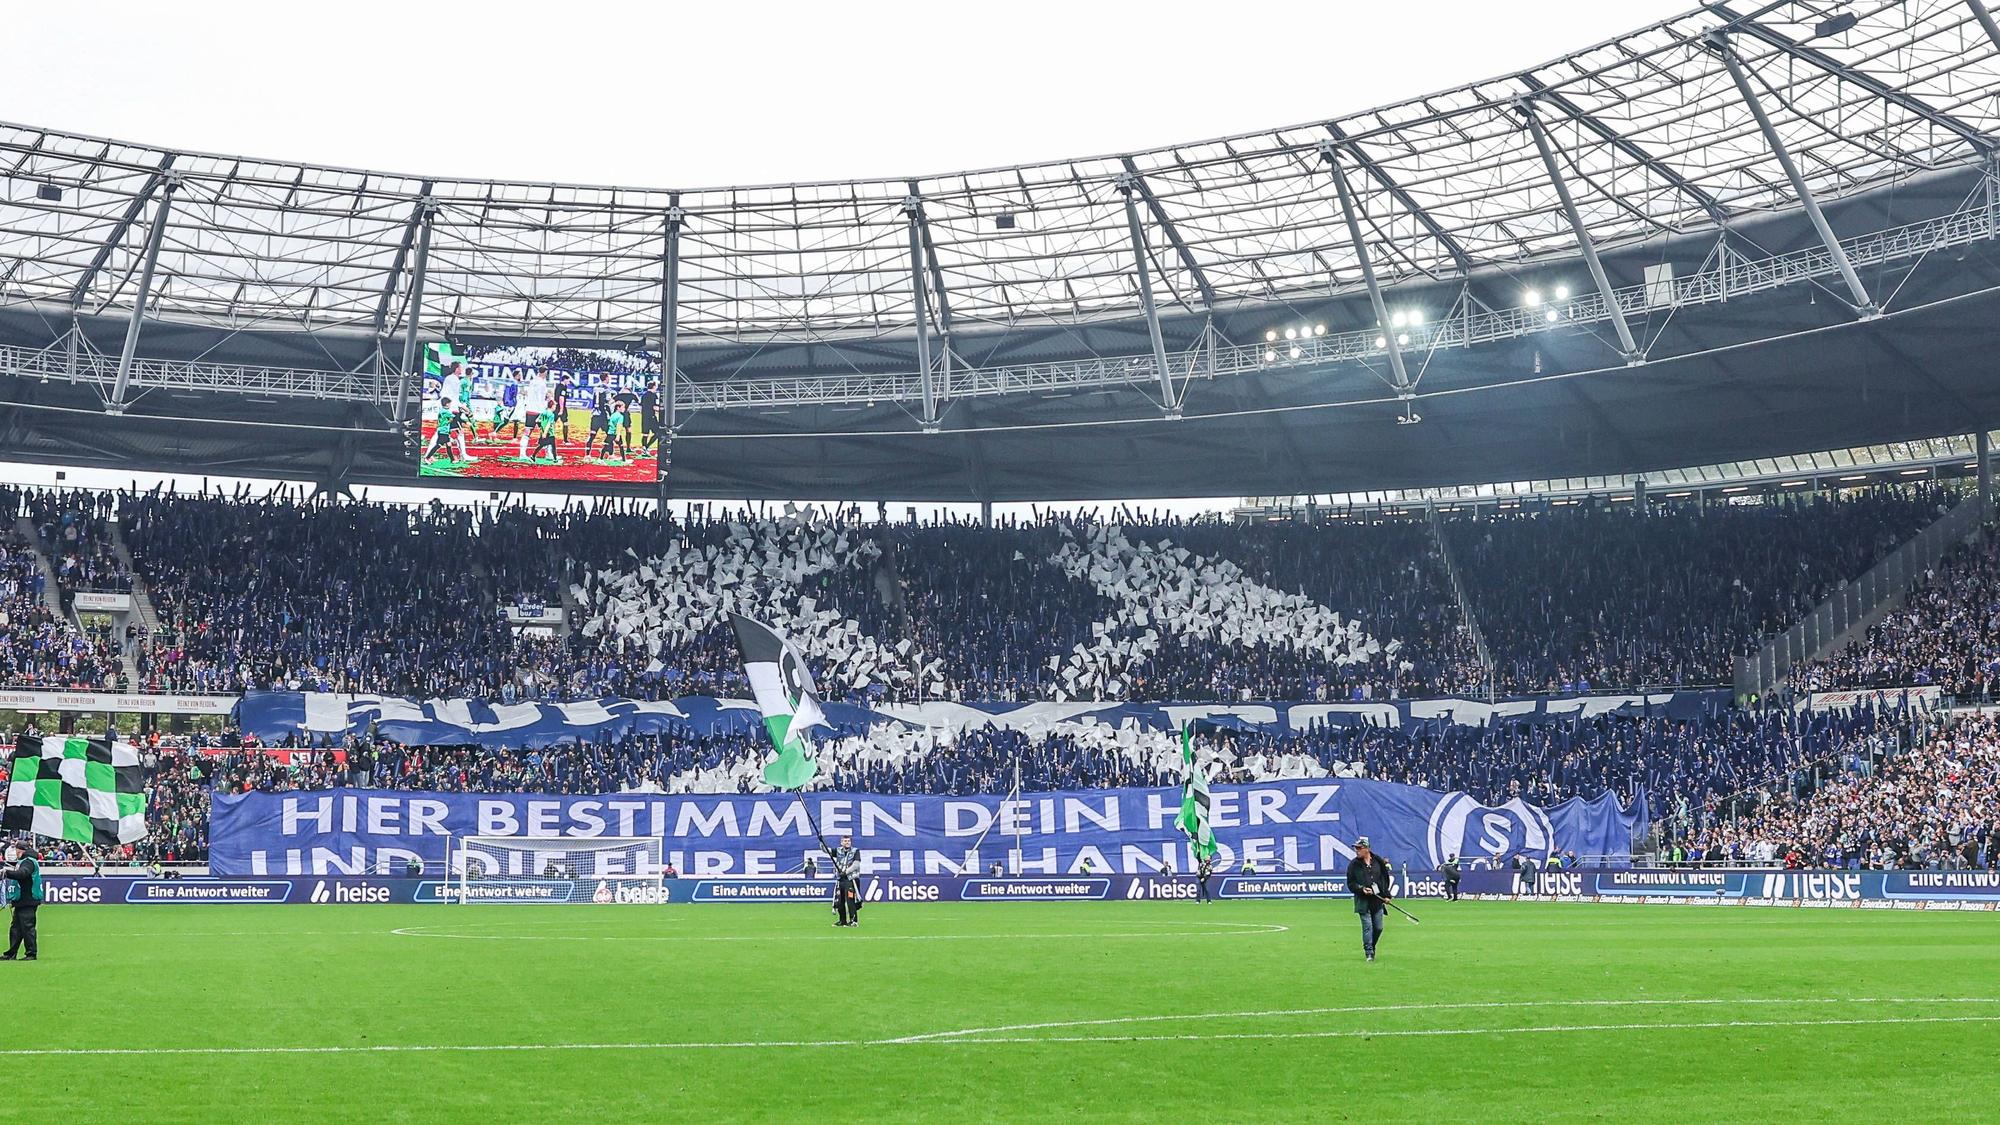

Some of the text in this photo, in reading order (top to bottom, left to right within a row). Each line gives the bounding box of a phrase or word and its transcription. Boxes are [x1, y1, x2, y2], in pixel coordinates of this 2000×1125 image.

[282, 785, 1341, 837] HIER BESTIMMEN DEIN HERZ
[1237, 881, 1344, 893] Eine Antwort weiter
[1945, 873, 2000, 887] Antwo
[45, 881, 102, 902] heise
[147, 886, 270, 898] Eine Antwort weiter
[335, 881, 390, 902] heise
[463, 886, 513, 897] Antwort
[514, 886, 554, 897] weiter
[712, 885, 827, 897] Eine Antwort weiter
[888, 881, 940, 900] heise
[981, 883, 1091, 896] Eine Antwort weiter
[1150, 879, 1198, 899] heise
